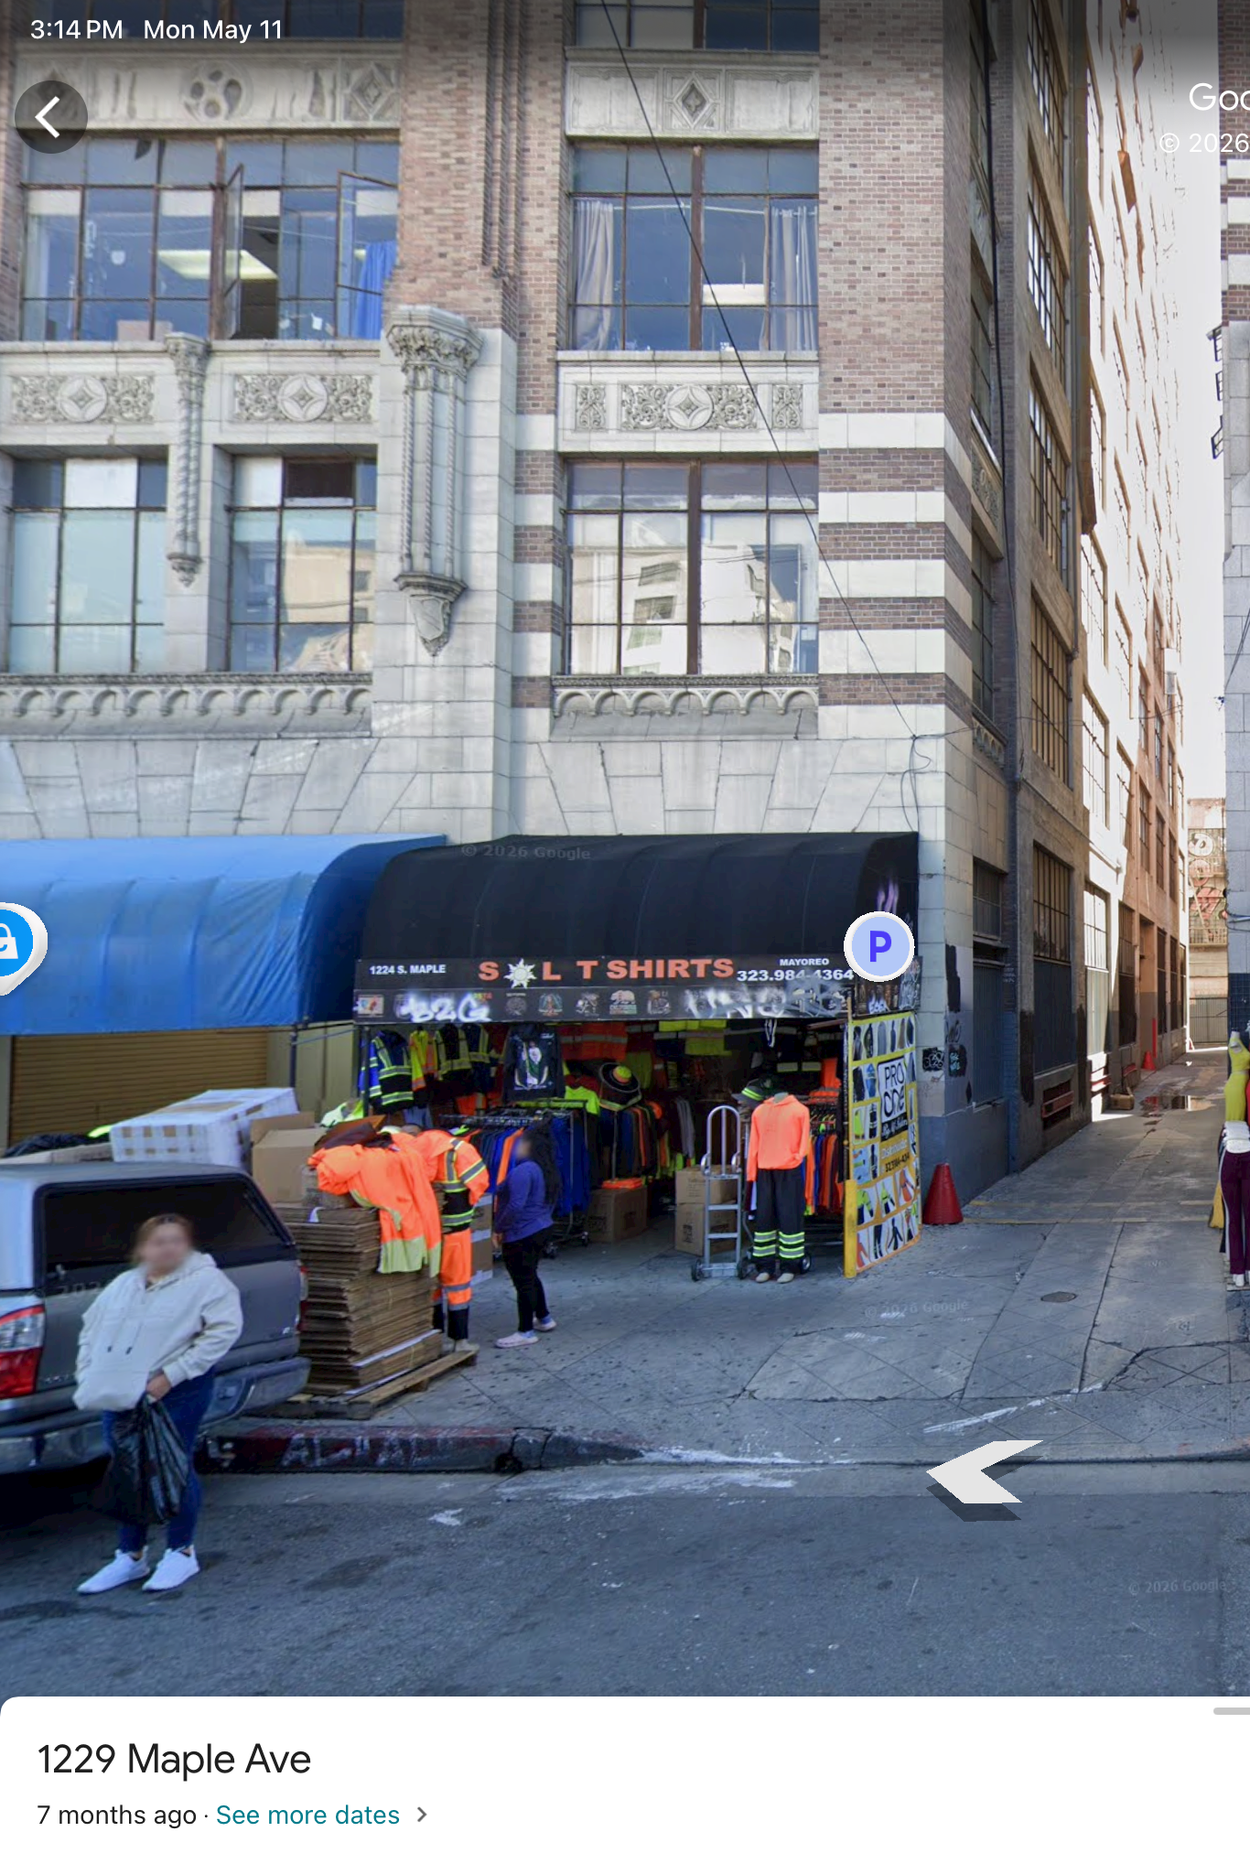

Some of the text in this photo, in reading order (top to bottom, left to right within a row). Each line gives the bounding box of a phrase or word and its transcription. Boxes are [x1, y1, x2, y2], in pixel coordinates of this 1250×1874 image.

[779, 957, 830, 967] MAYOREO
[369, 964, 446, 975] 1224 S. MAPLE
[606, 958, 735, 980] SHIRTS
[736, 969, 855, 982] 323.984-4364
[884, 1061, 905, 1090] PRO
